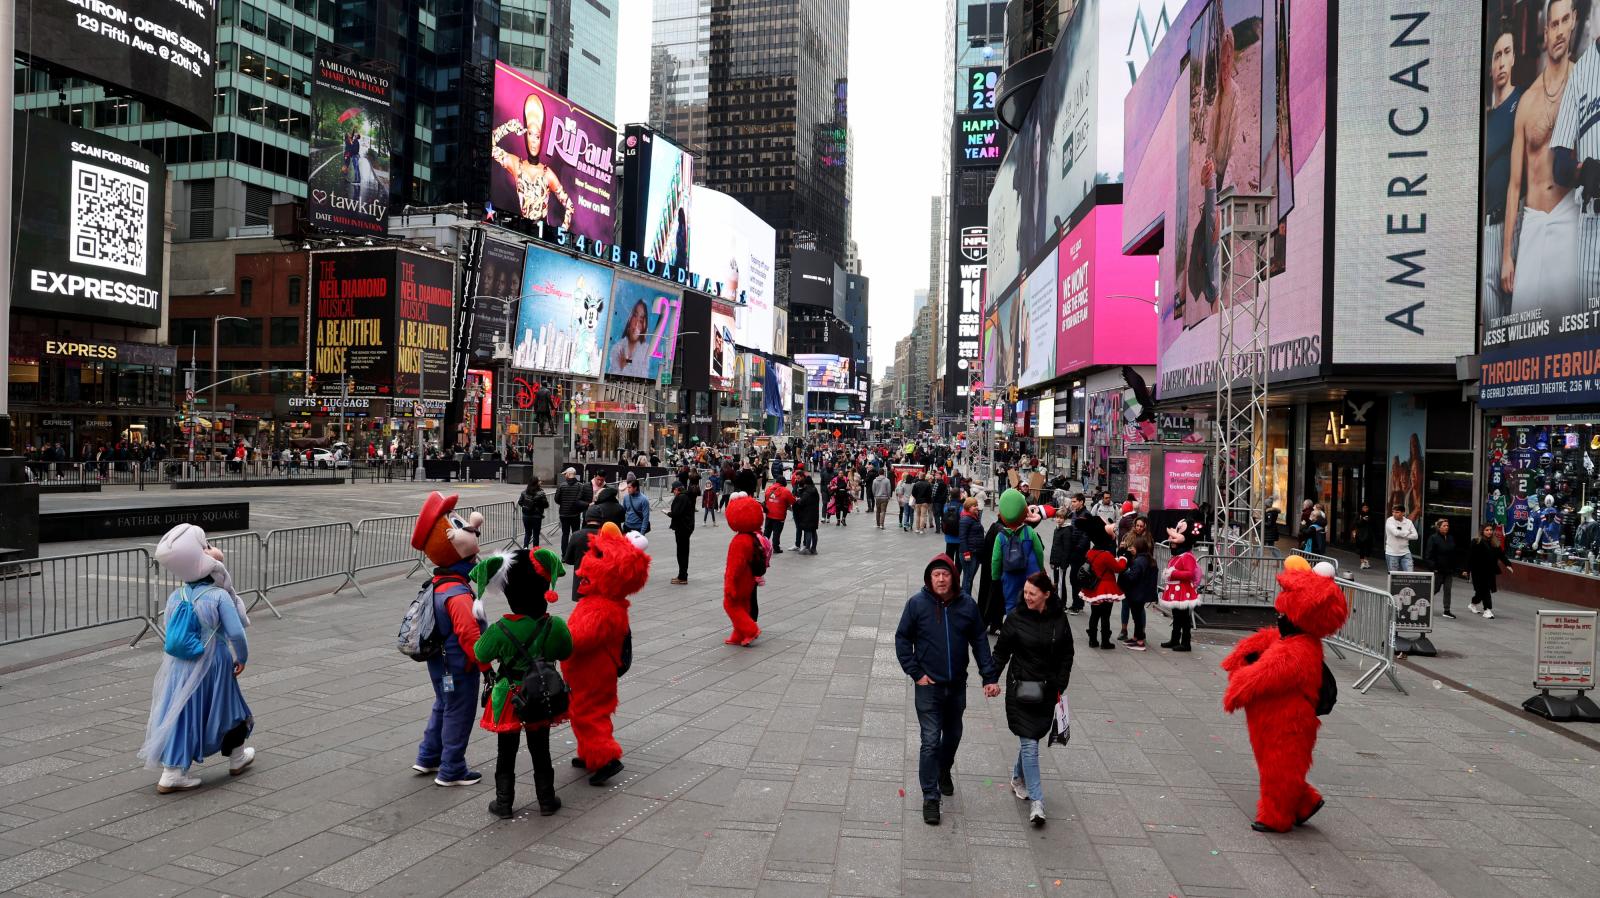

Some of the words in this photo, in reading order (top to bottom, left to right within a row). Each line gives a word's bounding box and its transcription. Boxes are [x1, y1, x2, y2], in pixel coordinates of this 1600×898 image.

[76, 13, 99, 32] 129
[101, 22, 130, 45] Fifth
[132, 35, 157, 55] Ave.
[159, 46, 170, 59] @
[171, 51, 192, 71] 20th
[192, 62, 203, 77] St.
[134, 17, 179, 45] OPENS
[180, 36, 203, 60] SEPT.
[319, 59, 325, 67] A
[326, 61, 357, 78] MILLION
[358, 72, 377, 84] WAYS
[379, 78, 388, 88] TO
[321, 67, 344, 82] SHARE
[962, 119, 1000, 132] HAPPY
[547, 116, 614, 174] RuPaul's
[967, 133, 996, 146] NEW
[71, 141, 102, 158] SCAN
[101, 149, 122, 164] FOR
[121, 155, 150, 175] DETAILS
[626, 148, 636, 156] LG
[964, 146, 1000, 160] YEAR!
[577, 160, 596, 177] DRAG
[595, 167, 612, 184] RACE
[1384, 11, 1431, 337] AMERICAN
[329, 191, 387, 222] tawkify
[577, 195, 593, 208] Now
[592, 201, 601, 212] on
[315, 212, 333, 222] DATE
[964, 236, 988, 246] NFL
[537, 220, 602, 257] 1540
[612, 244, 725, 296] BROADWAY
[320, 261, 336, 280] THE
[402, 262, 415, 282] THE
[319, 281, 340, 299] NEIL
[341, 278, 387, 298] DIAMOND
[401, 281, 418, 301] NEIL
[418, 286, 452, 308] DIAMOND
[1062, 275, 1071, 301] WE
[318, 299, 356, 318] MUSICAL
[400, 301, 429, 321] MUSICAL
[1490, 317, 1501, 328] TONY
[1501, 313, 1519, 325] AWARD
[1520, 308, 1543, 322] NOMINEE
[317, 320, 323, 346] A
[326, 318, 383, 347] BEAUTIFUL
[1559, 312, 1590, 333] JESSE
[399, 320, 405, 342] A
[407, 321, 449, 351] BEAUTIFUL
[1483, 328, 1506, 347] JESSE
[1508, 319, 1550, 342] WILLIAMS
[46, 340, 117, 359] EXPRESS
[315, 346, 348, 374] NOISE
[1481, 355, 1540, 385] THROUGH
[1160, 362, 1203, 392] AMERICAN
[1486, 388, 1507, 399] GERALD
[1507, 384, 1540, 397] SCHOENFELD
[1542, 381, 1568, 394] THEATRE,
[288, 398, 316, 407] GIFTS
[323, 398, 369, 408] LUGGAGE
[394, 398, 413, 407] GIFTS
[1163, 417, 1190, 429] ALL.
[1519, 433, 1527, 445] 8
[1518, 459, 1531, 469] 17
[1519, 479, 1528, 492] 2
[118, 514, 161, 527] FATHER
[165, 512, 199, 524] DUFFY
[202, 509, 240, 521] SQUARE
